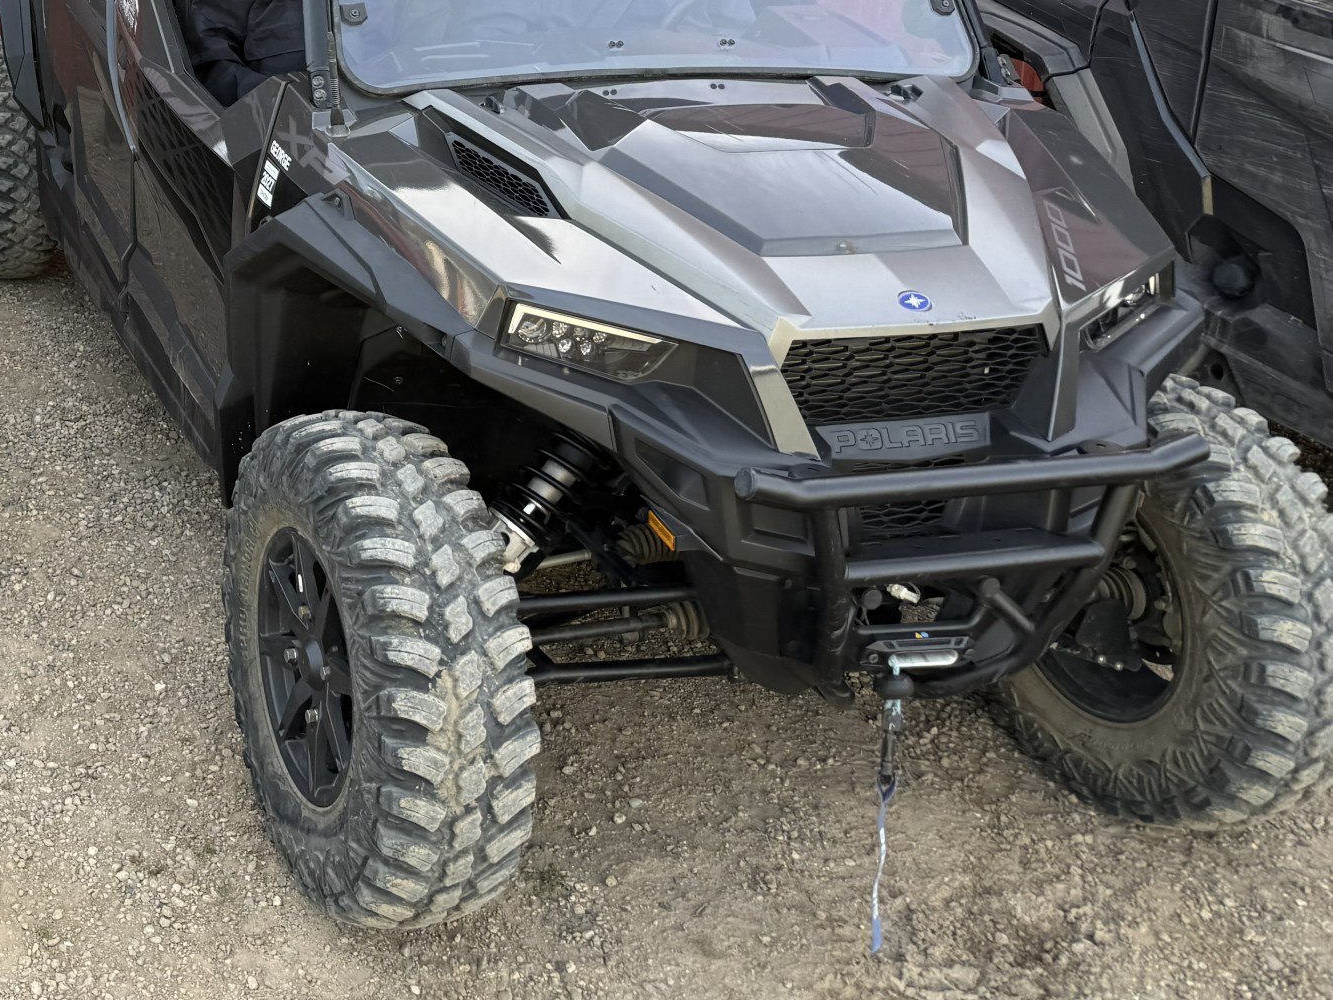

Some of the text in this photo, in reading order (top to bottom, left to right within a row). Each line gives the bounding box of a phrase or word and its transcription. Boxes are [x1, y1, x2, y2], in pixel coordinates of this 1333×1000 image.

[270, 140, 292, 172] GEORGE
[1043, 200, 1087, 292] 1000
[830, 420, 981, 454] POLARIS
